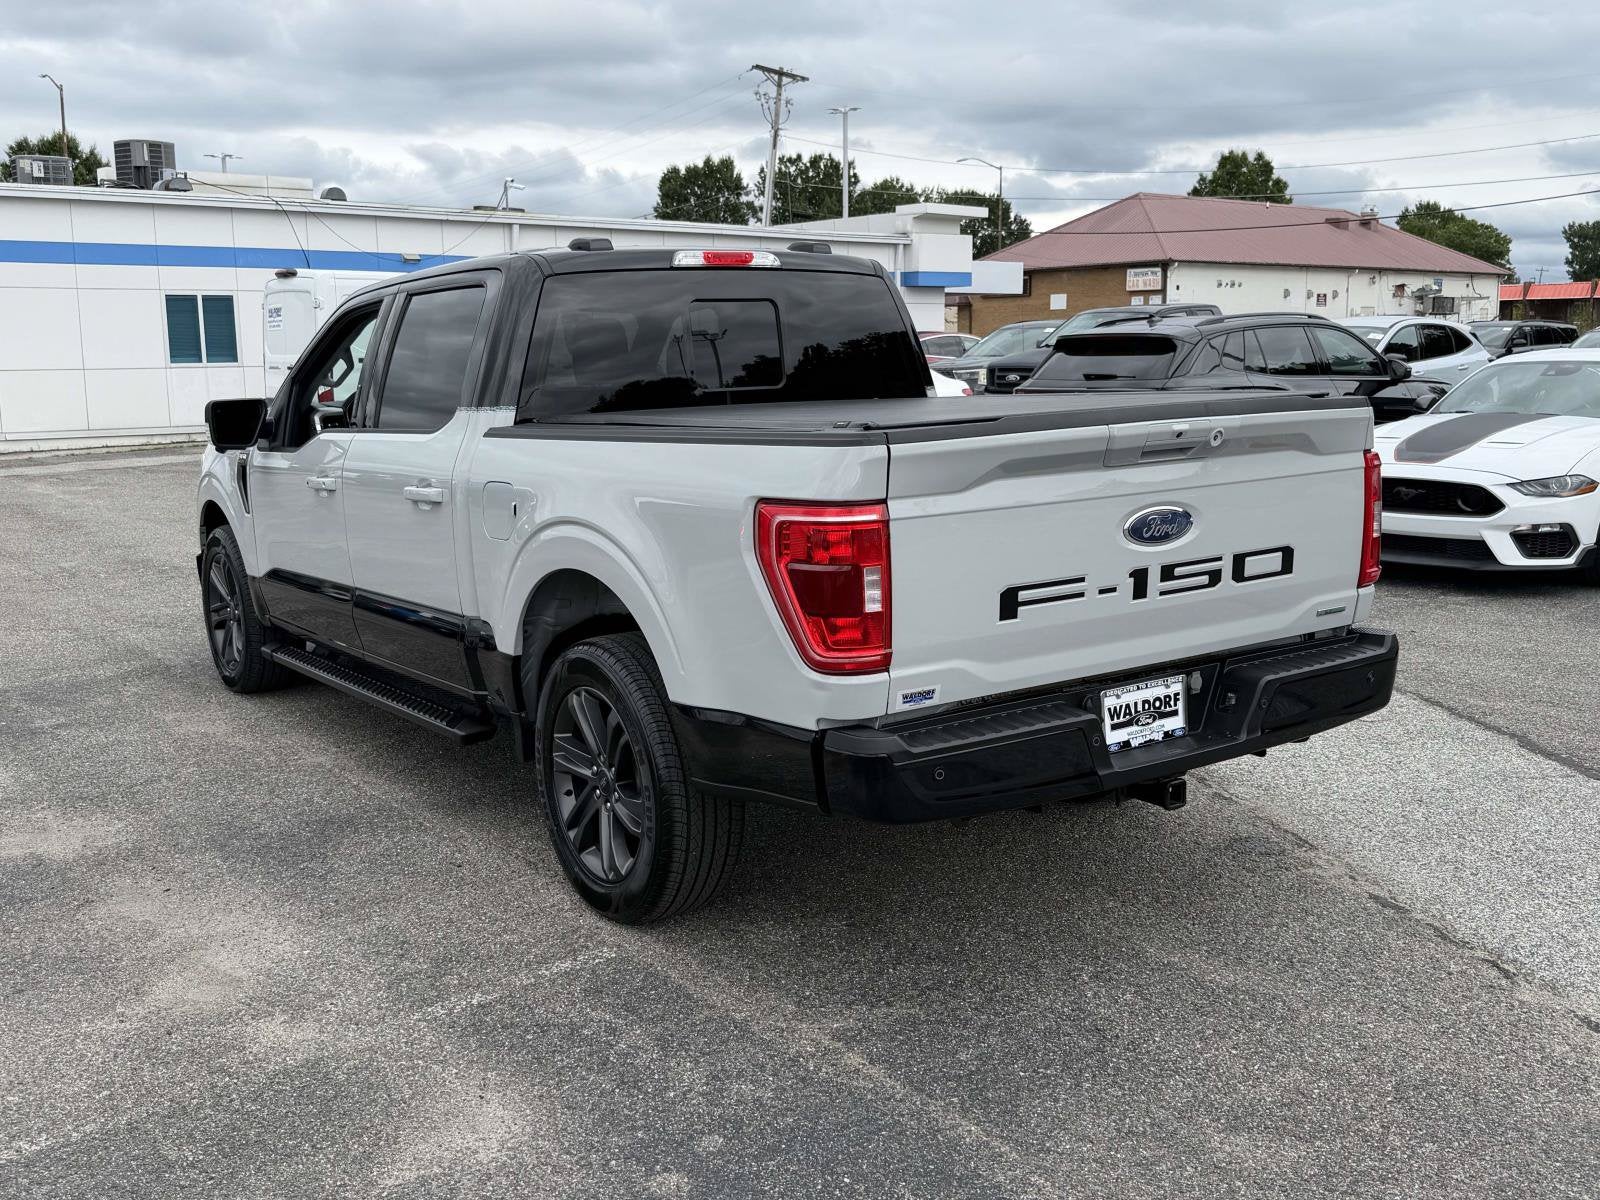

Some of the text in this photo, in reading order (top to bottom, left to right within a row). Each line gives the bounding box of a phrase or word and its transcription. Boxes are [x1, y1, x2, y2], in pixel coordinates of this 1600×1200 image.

[1128, 278, 1160, 289] CAR WASH
[1143, 513, 1180, 538] Ford
[998, 545, 1294, 622] F-150
[902, 688, 936, 700] WALDORF
[1106, 686, 1138, 697] DEDICATED
[1147, 677, 1183, 687] EXCELLENCE
[1107, 692, 1181, 722] WALDORF
